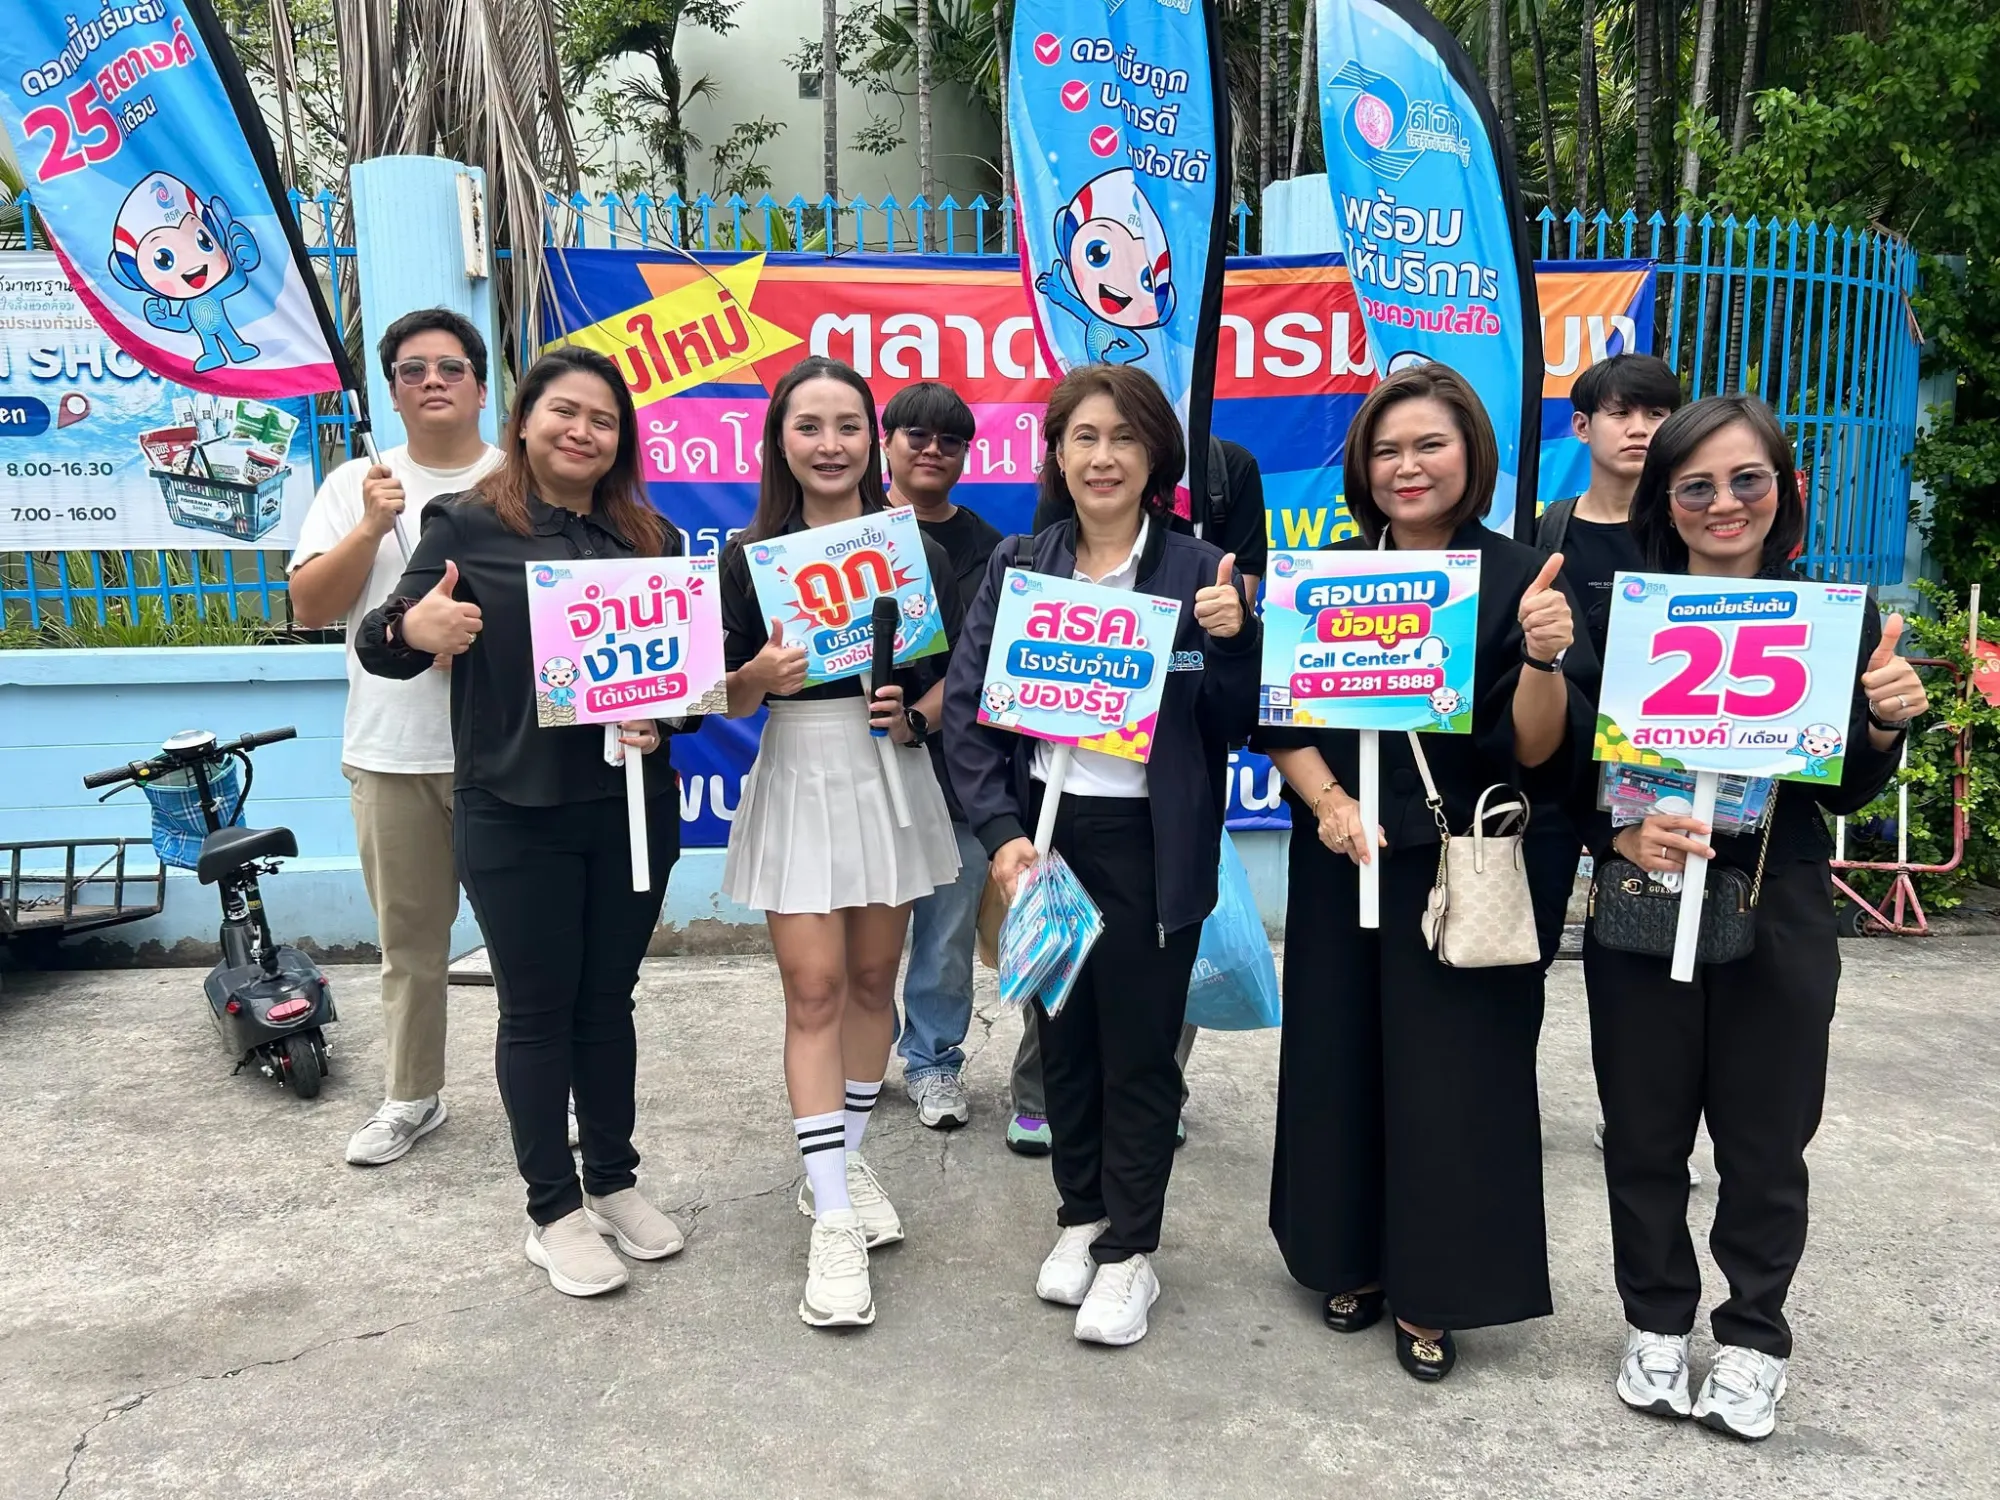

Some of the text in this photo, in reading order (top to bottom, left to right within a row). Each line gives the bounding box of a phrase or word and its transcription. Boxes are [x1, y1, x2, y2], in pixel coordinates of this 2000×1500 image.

[22, 16, 196, 182] 25 สตางค์
[1340, 187, 1463, 247] พร้อม
[1345, 231, 1499, 301] ให้บริการ
[28, 343, 160, 379] SHO
[11, 507, 51, 521] 7.00
[67, 507, 117, 521] 16.00
[824, 527, 883, 558] ดอกเบี้ย
[794, 549, 895, 628] ถูก
[1308, 580, 1436, 607] สอบถาม
[1671, 595, 1791, 617] ดอกเบี้ยเริ่มต้น
[567, 575, 689, 639] จำนำ
[1026, 601, 1146, 647] สธค.
[1330, 608, 1420, 645] ข้อมูล
[583, 633, 680, 683] ง่าย
[1019, 648, 1140, 680] โรงรับจำนำ
[1299, 652, 1411, 669] Call Center
[1641, 624, 1809, 717] 25
[593, 677, 681, 707] ได้เงินเร็ว
[1321, 674, 1436, 692] 0 2281 5888
[1018, 680, 1127, 725] ของรัฐ
[1633, 722, 1788, 745] สตางค์ /เดือน
